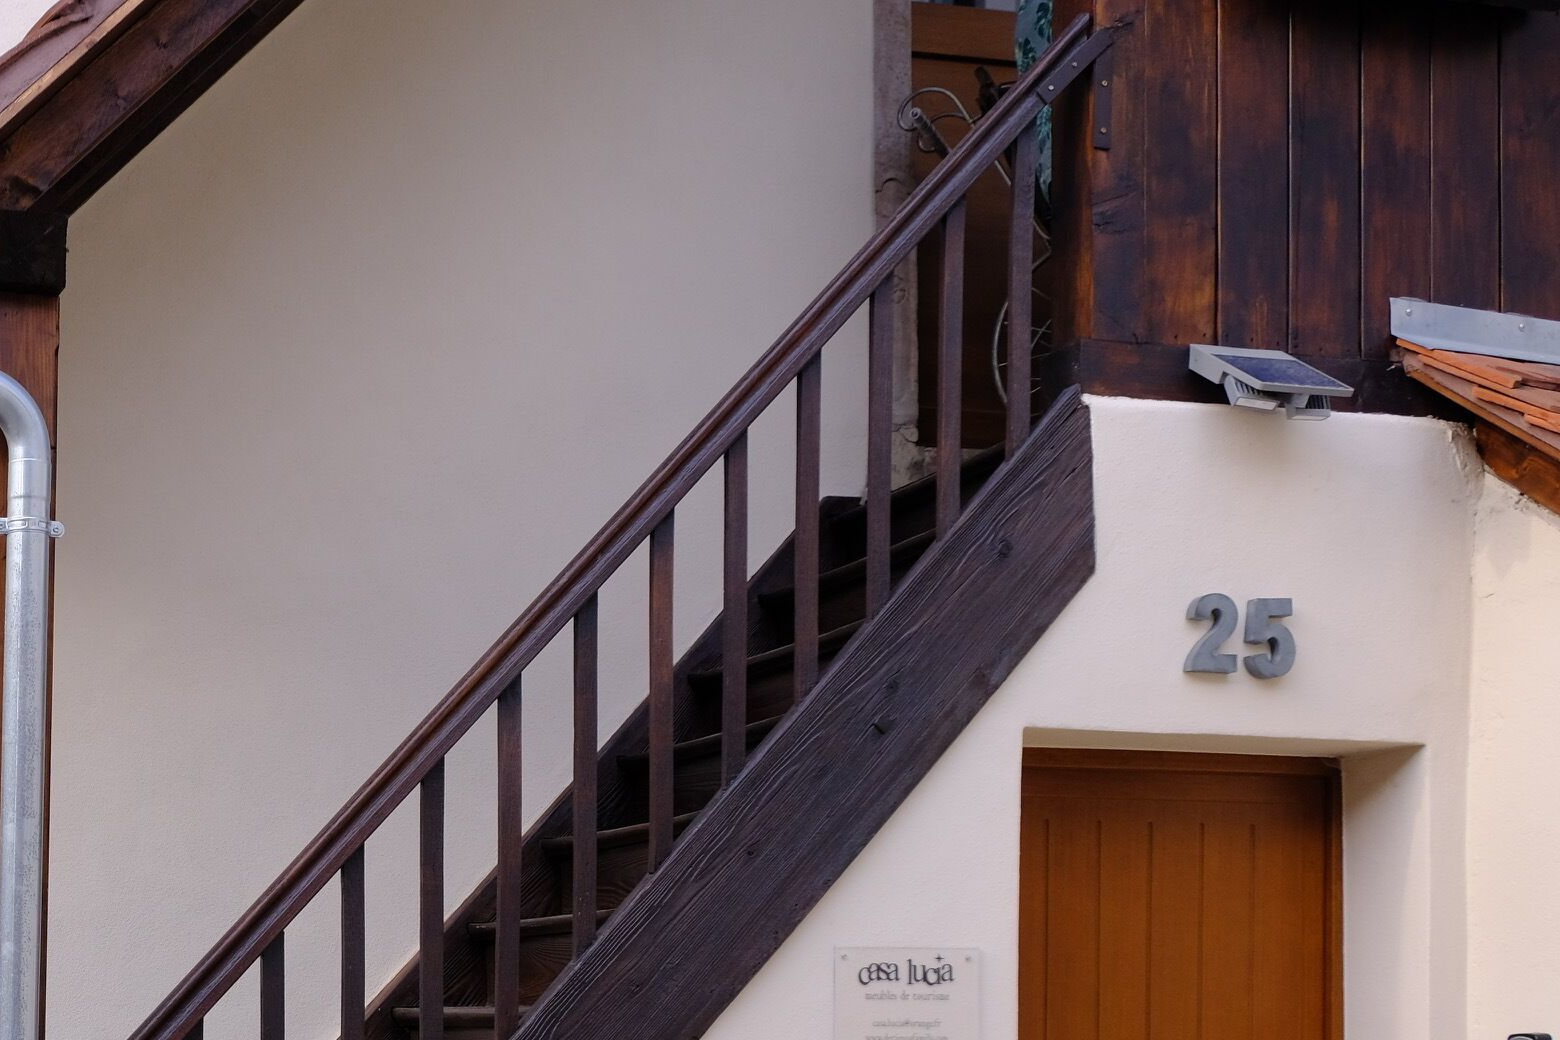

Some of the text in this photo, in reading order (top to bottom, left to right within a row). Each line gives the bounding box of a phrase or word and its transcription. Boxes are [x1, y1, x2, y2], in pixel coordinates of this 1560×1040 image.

[1183, 593, 1296, 679] 25
[858, 954, 956, 985] casa lucia
